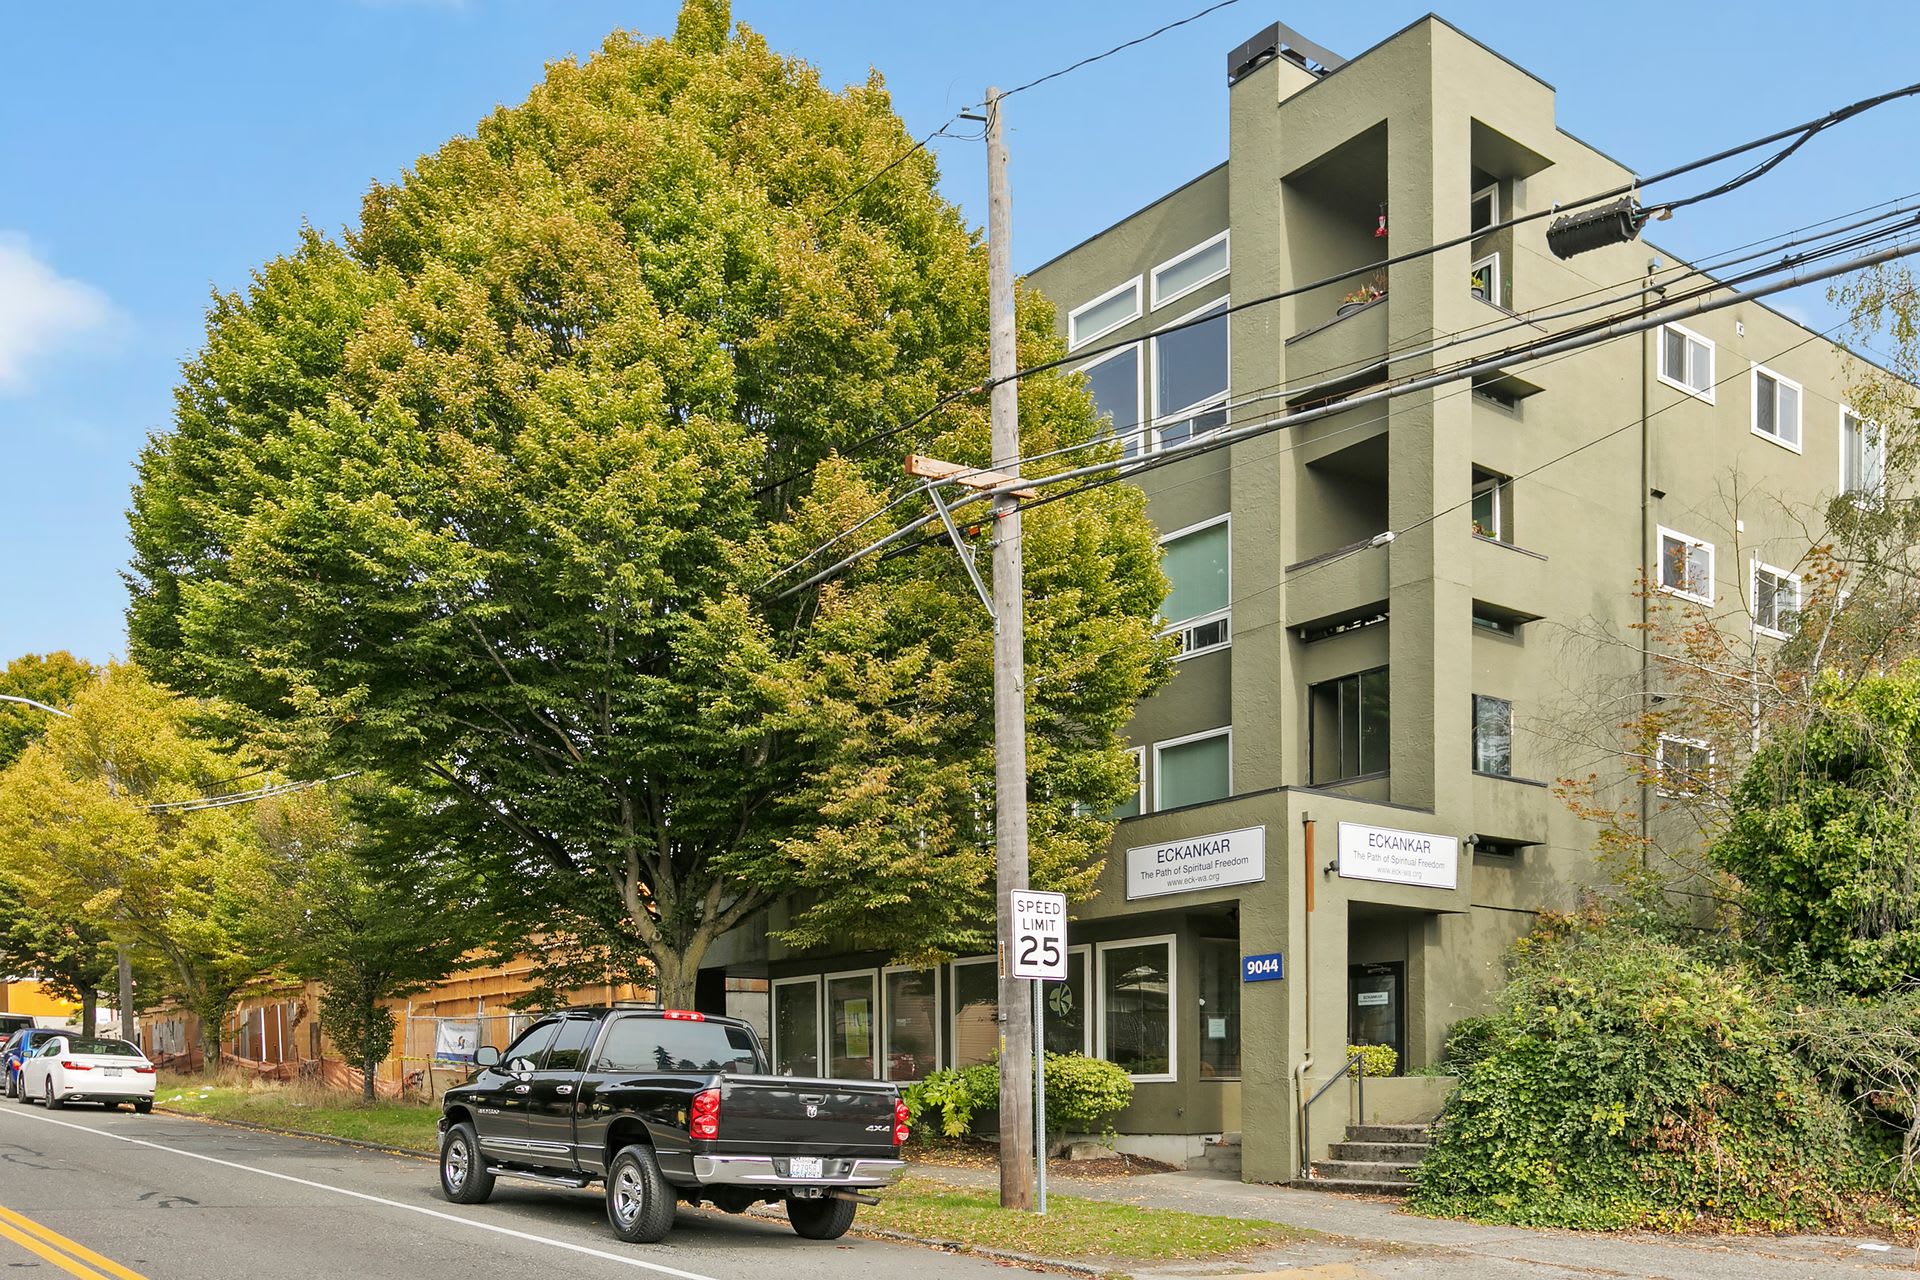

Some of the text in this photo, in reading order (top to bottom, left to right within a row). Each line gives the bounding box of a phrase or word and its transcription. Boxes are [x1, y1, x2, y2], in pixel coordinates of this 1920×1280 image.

[1157, 839, 1230, 864] ECKANKAR
[1369, 833, 1431, 854] ECKANKAR
[1140, 856, 1249, 880] The Path of Spiritual Freedom
[1353, 850, 1445, 869] The Path of Spiritual Freedom
[1166, 872, 1220, 887] www.eck-wa.org
[1017, 899, 1060, 915] SPEED
[1022, 917, 1056, 932] LIMIT
[1020, 935, 1060, 967] 25
[1247, 959, 1279, 975] 9044
